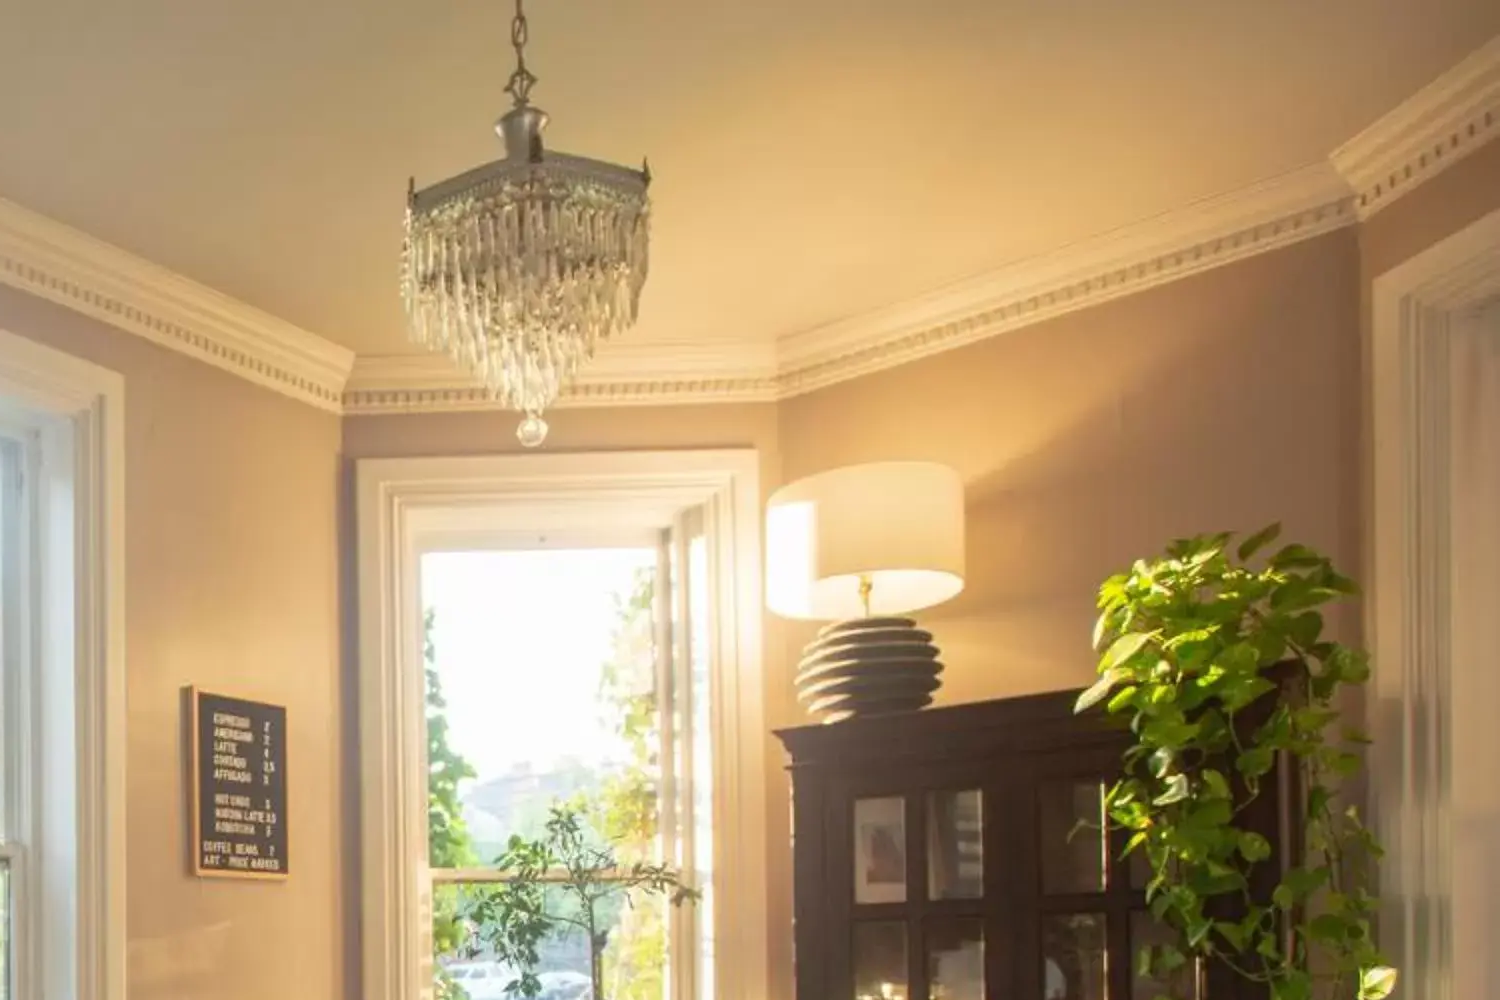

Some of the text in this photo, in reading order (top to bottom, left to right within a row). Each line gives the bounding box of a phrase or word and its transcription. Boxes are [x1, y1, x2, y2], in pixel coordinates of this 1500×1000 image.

[213, 740, 237, 755] LATTE
[213, 768, 252, 784] AFFOGADO
[243, 810, 265, 823] LATTE
[203, 841, 232, 854] COFFEE
[235, 843, 260, 856] BEANS
[203, 855, 221, 866] ART
